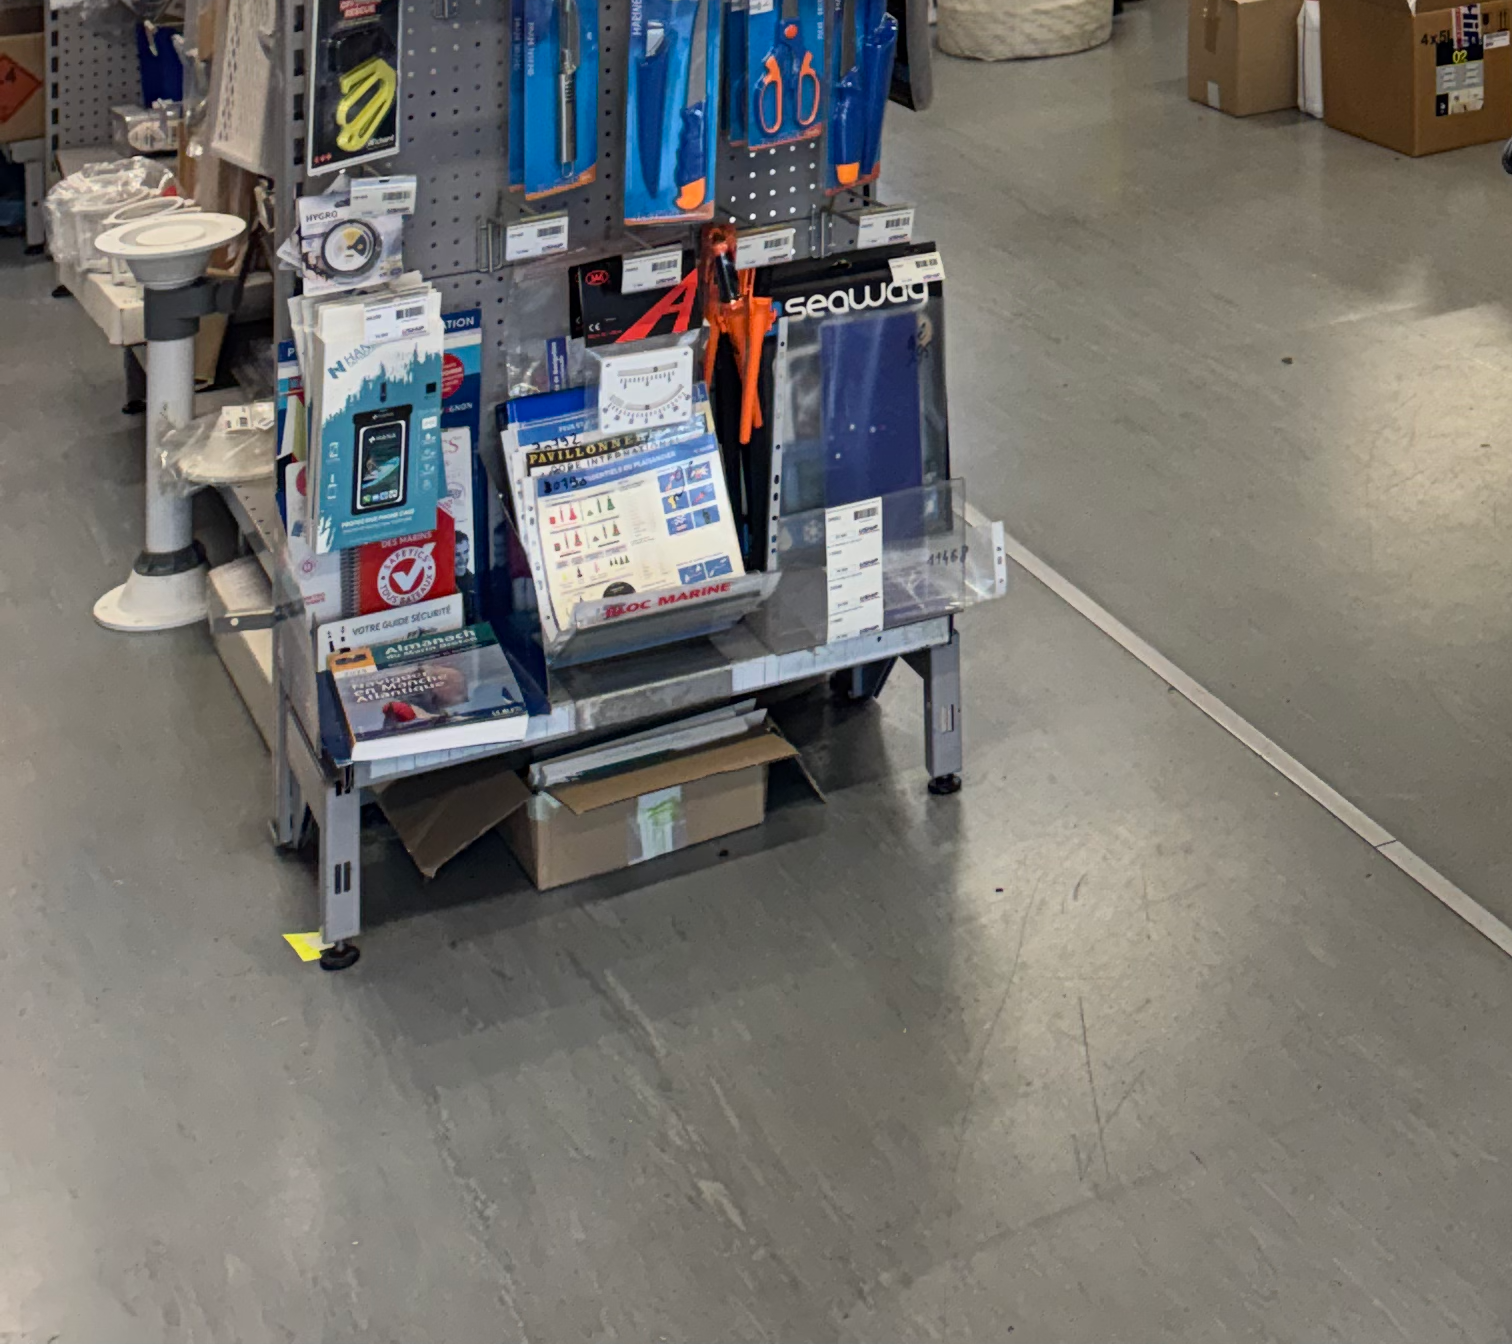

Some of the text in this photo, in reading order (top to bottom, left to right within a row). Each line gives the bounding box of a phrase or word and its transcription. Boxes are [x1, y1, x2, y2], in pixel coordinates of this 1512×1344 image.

[304, 210, 340, 223] HYGRO
[784, 279, 930, 321] seaway
[381, 531, 432, 549] DES MARINS
[379, 581, 398, 605] TOUS
[604, 581, 731, 619] BLOC MARINE
[351, 603, 452, 636] VOTRE GUIDE SÉCURITÉ
[383, 627, 477, 656] Almanach
[403, 643, 434, 658] Marin
[356, 678, 445, 703] Atlantique
[377, 673, 449, 694] Manche
